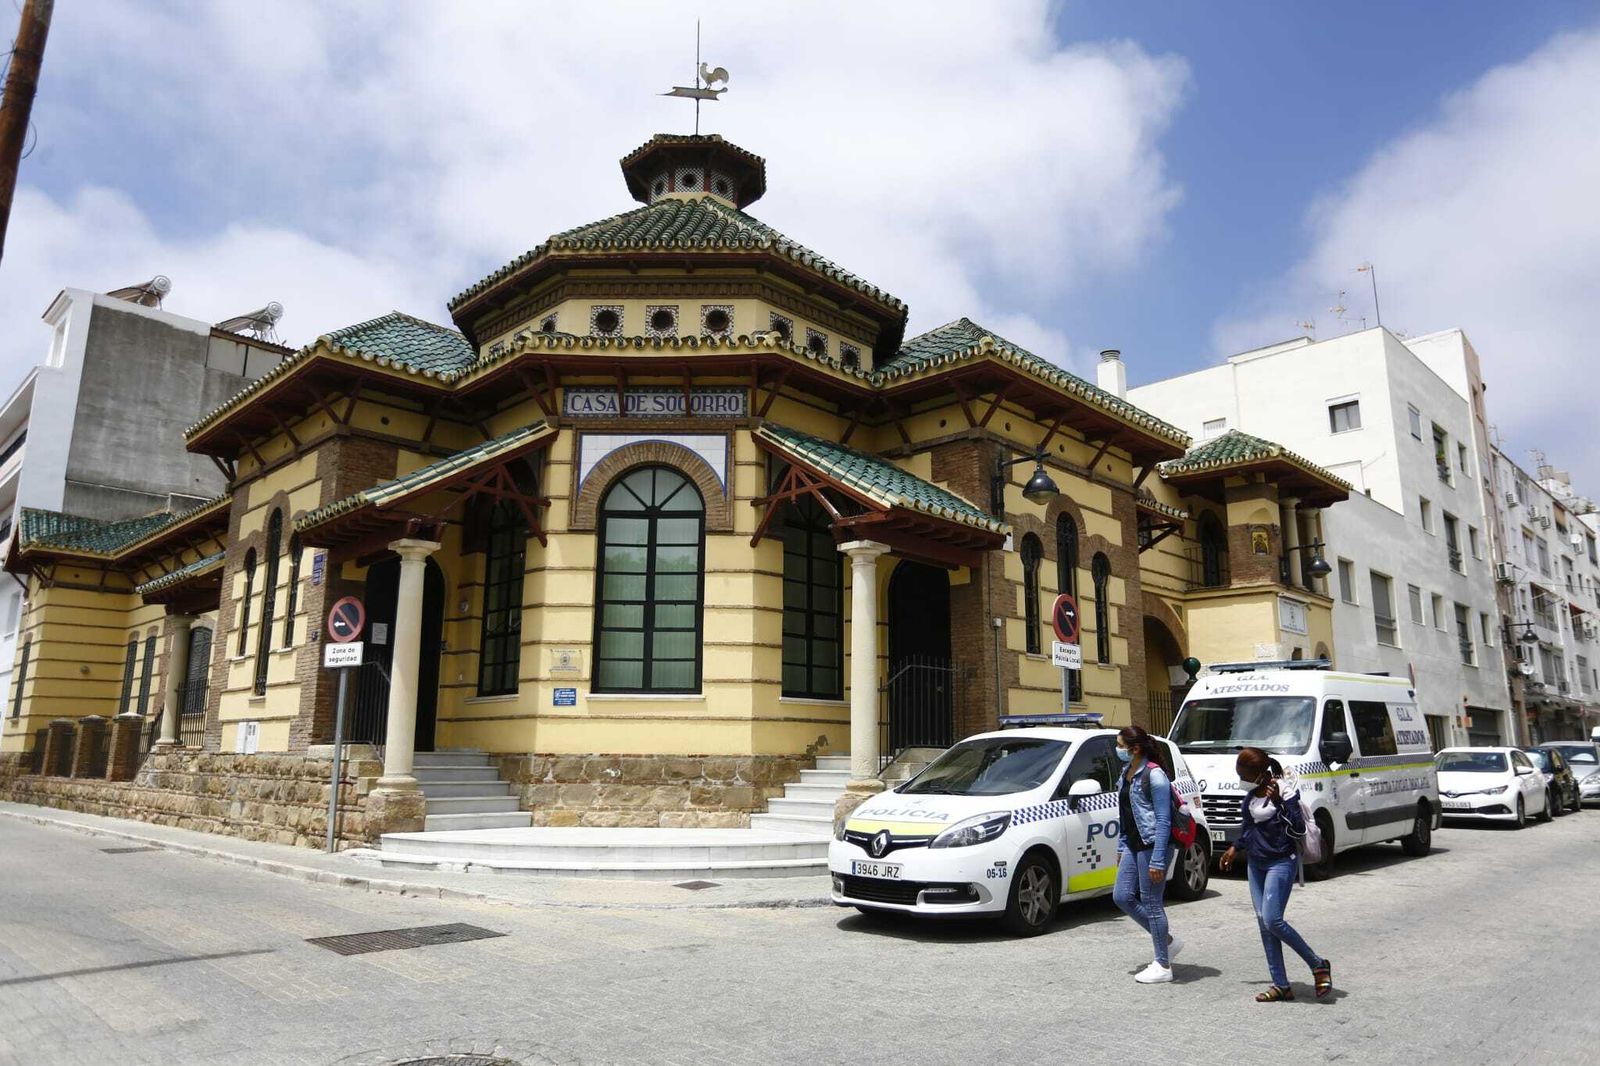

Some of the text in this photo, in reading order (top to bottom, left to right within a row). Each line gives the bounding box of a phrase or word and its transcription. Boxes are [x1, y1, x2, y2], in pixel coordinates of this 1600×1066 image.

[571, 395, 740, 412] CASA DE SOCORRO
[328, 655, 358, 663] seguridad
[1210, 683, 1290, 695] ATESTADOS
[857, 863, 900, 879] 3946 JRZ
[986, 868, 1008, 879] 05-16
